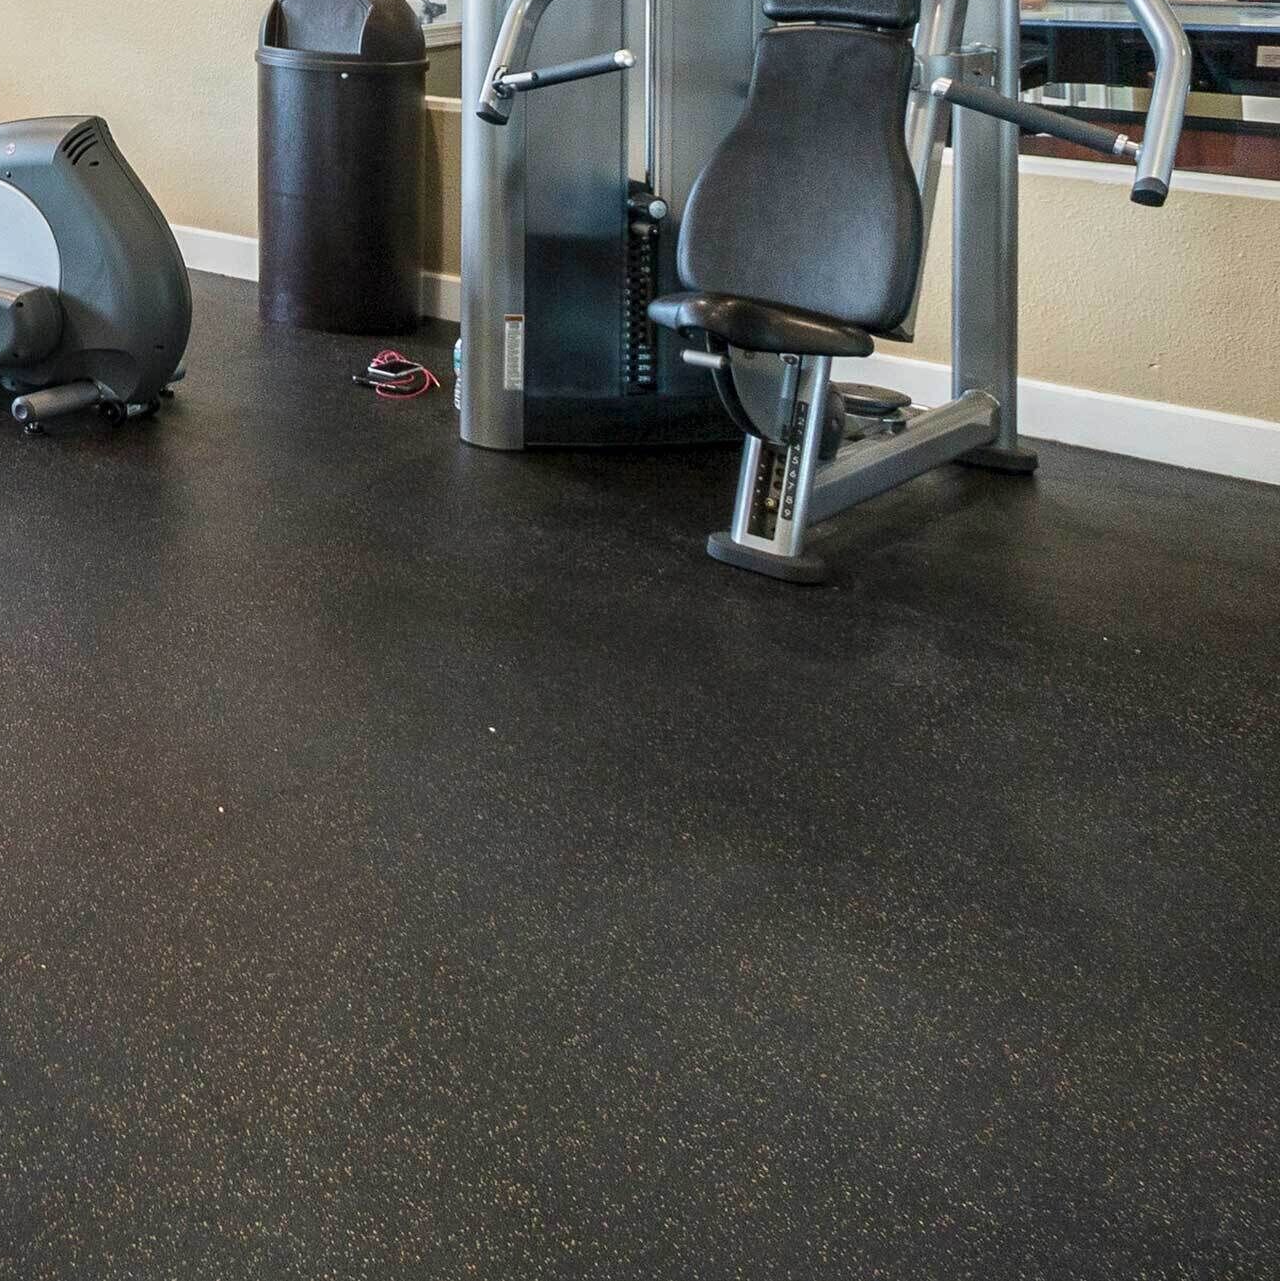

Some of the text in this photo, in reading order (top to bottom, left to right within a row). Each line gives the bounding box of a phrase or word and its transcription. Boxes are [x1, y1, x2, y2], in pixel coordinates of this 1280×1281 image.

[794, 443, 800, 451] 4
[792, 456, 799, 464] 5
[789, 469, 796, 478] 6
[785, 495, 793, 505] 8
[784, 508, 791, 517] 9
